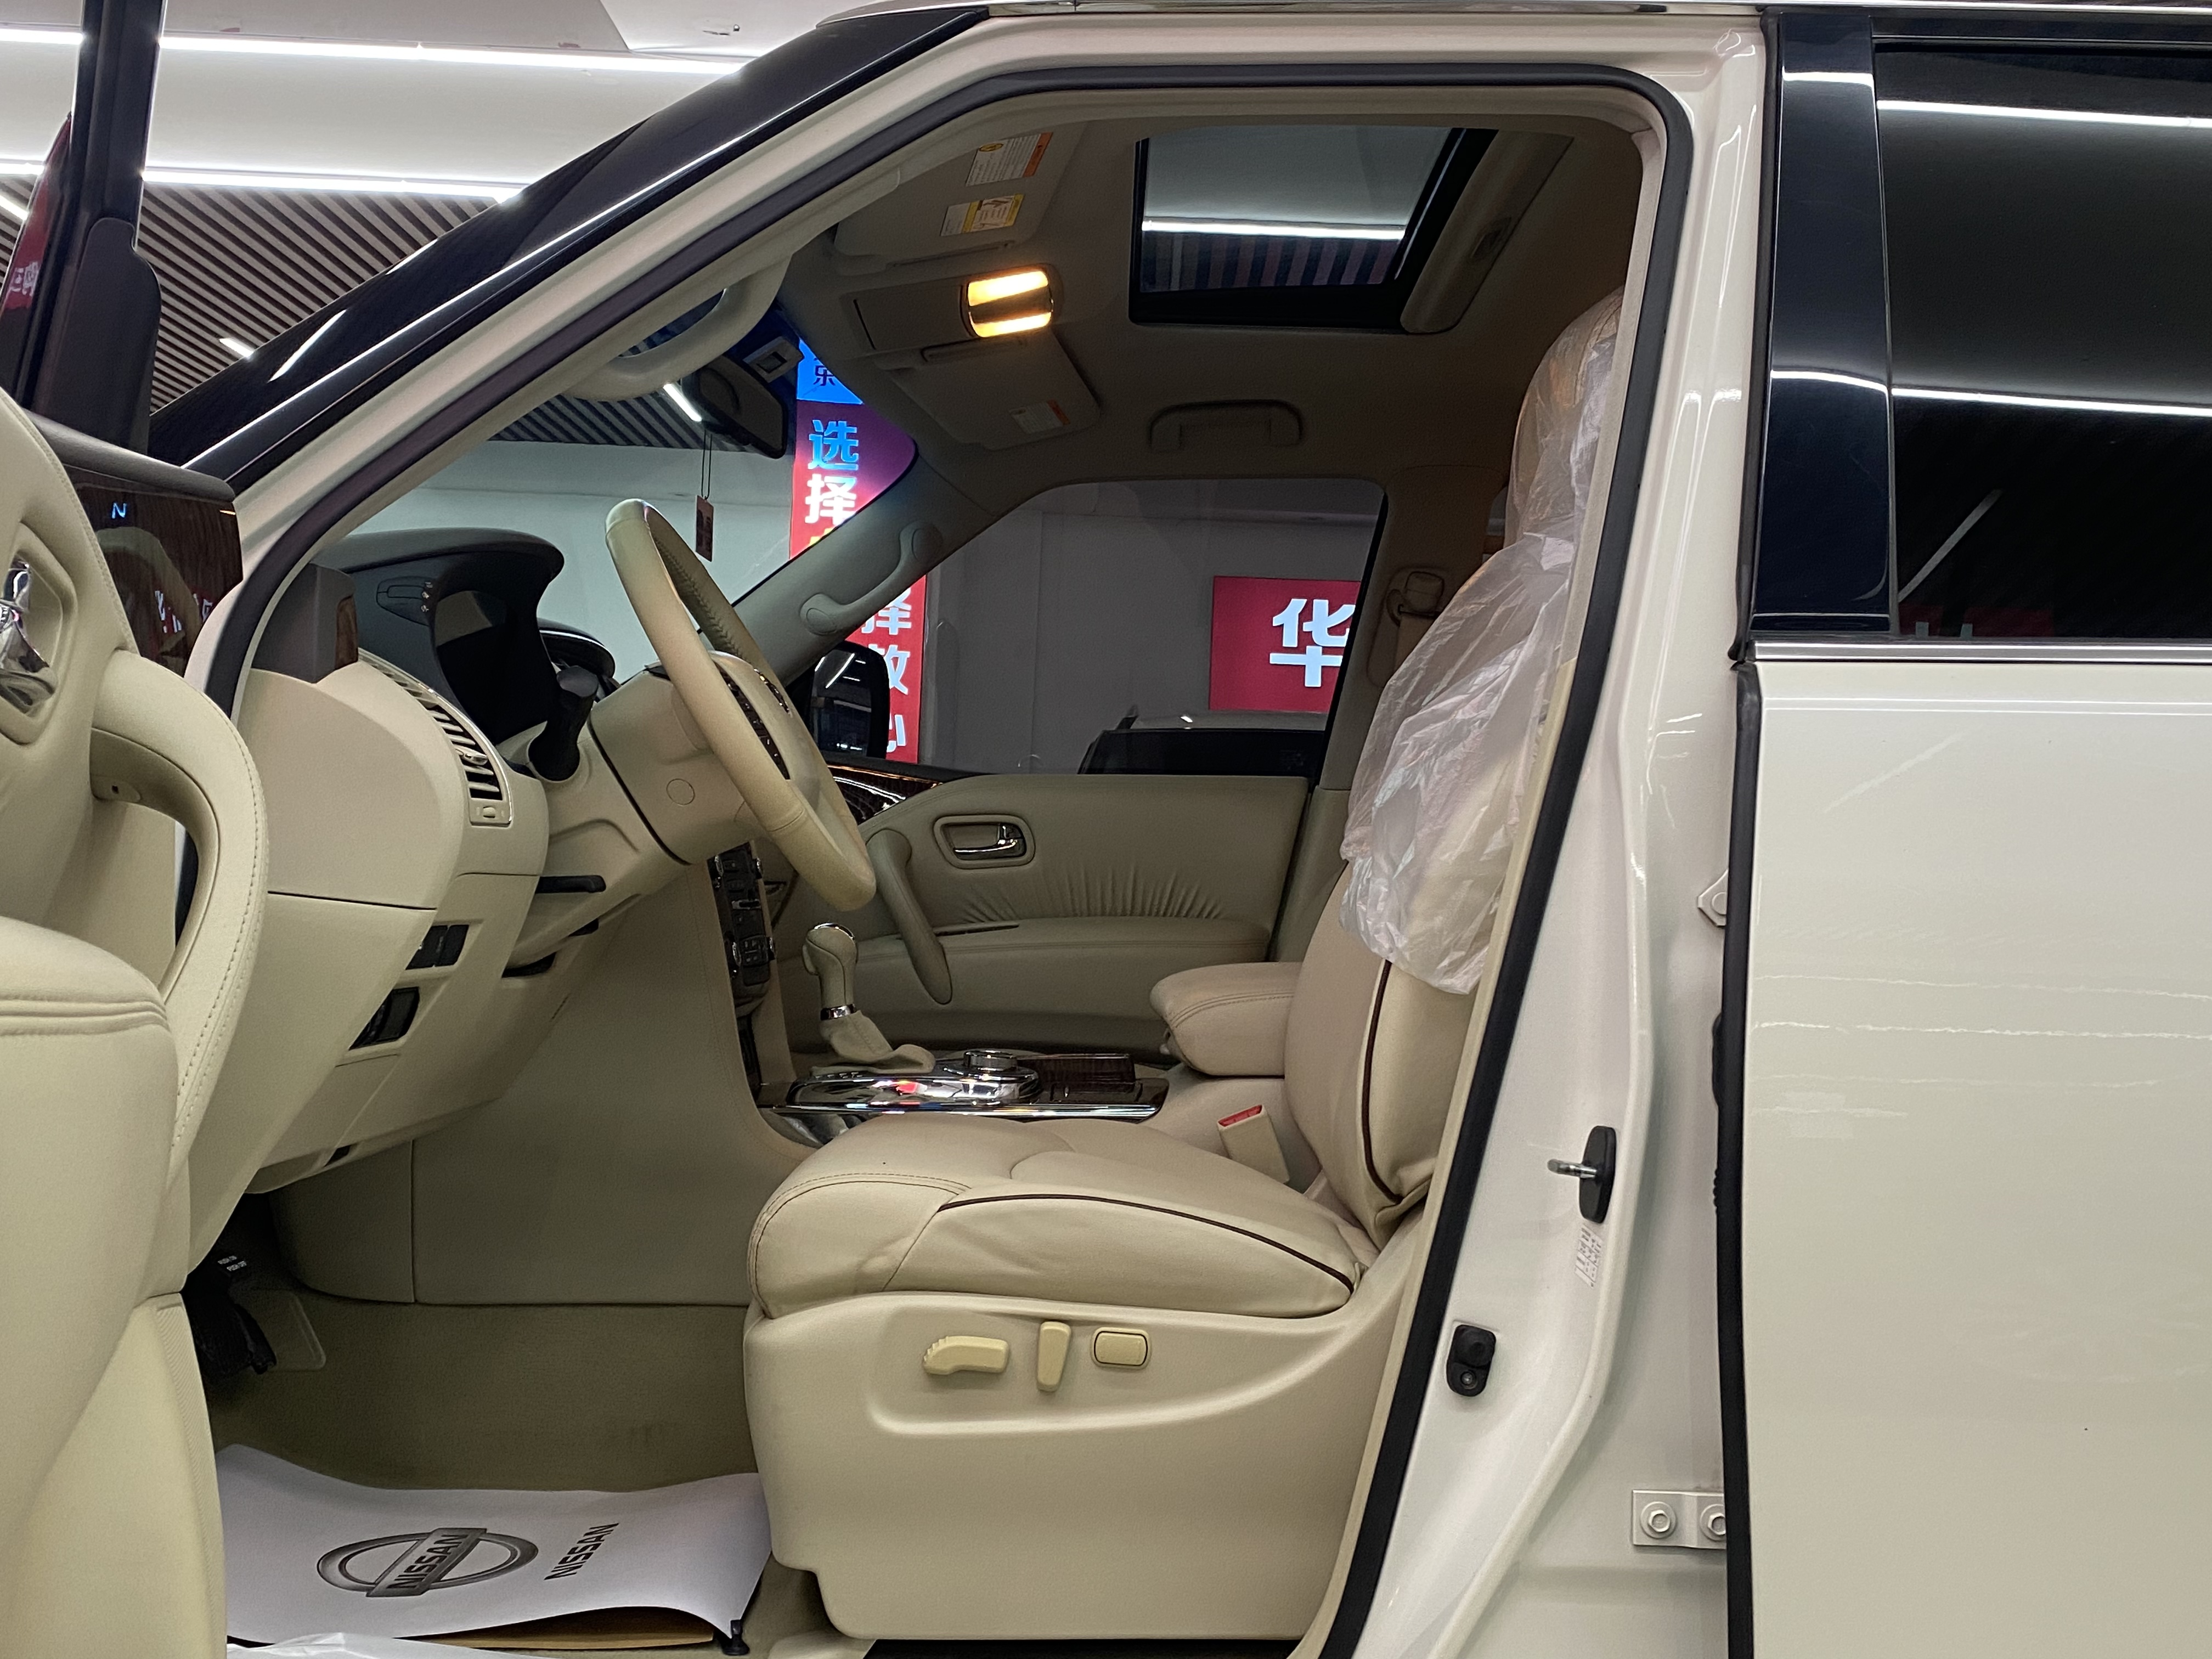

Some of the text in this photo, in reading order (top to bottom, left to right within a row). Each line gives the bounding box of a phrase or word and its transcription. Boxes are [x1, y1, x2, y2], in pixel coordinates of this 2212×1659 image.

[813, 357, 835, 386] 乐
[804, 419, 859, 546] 选择
[1269, 598, 1356, 687] 华
[386, 1534, 470, 1589] NISSAN
[543, 1522, 619, 1581] NISSAN
